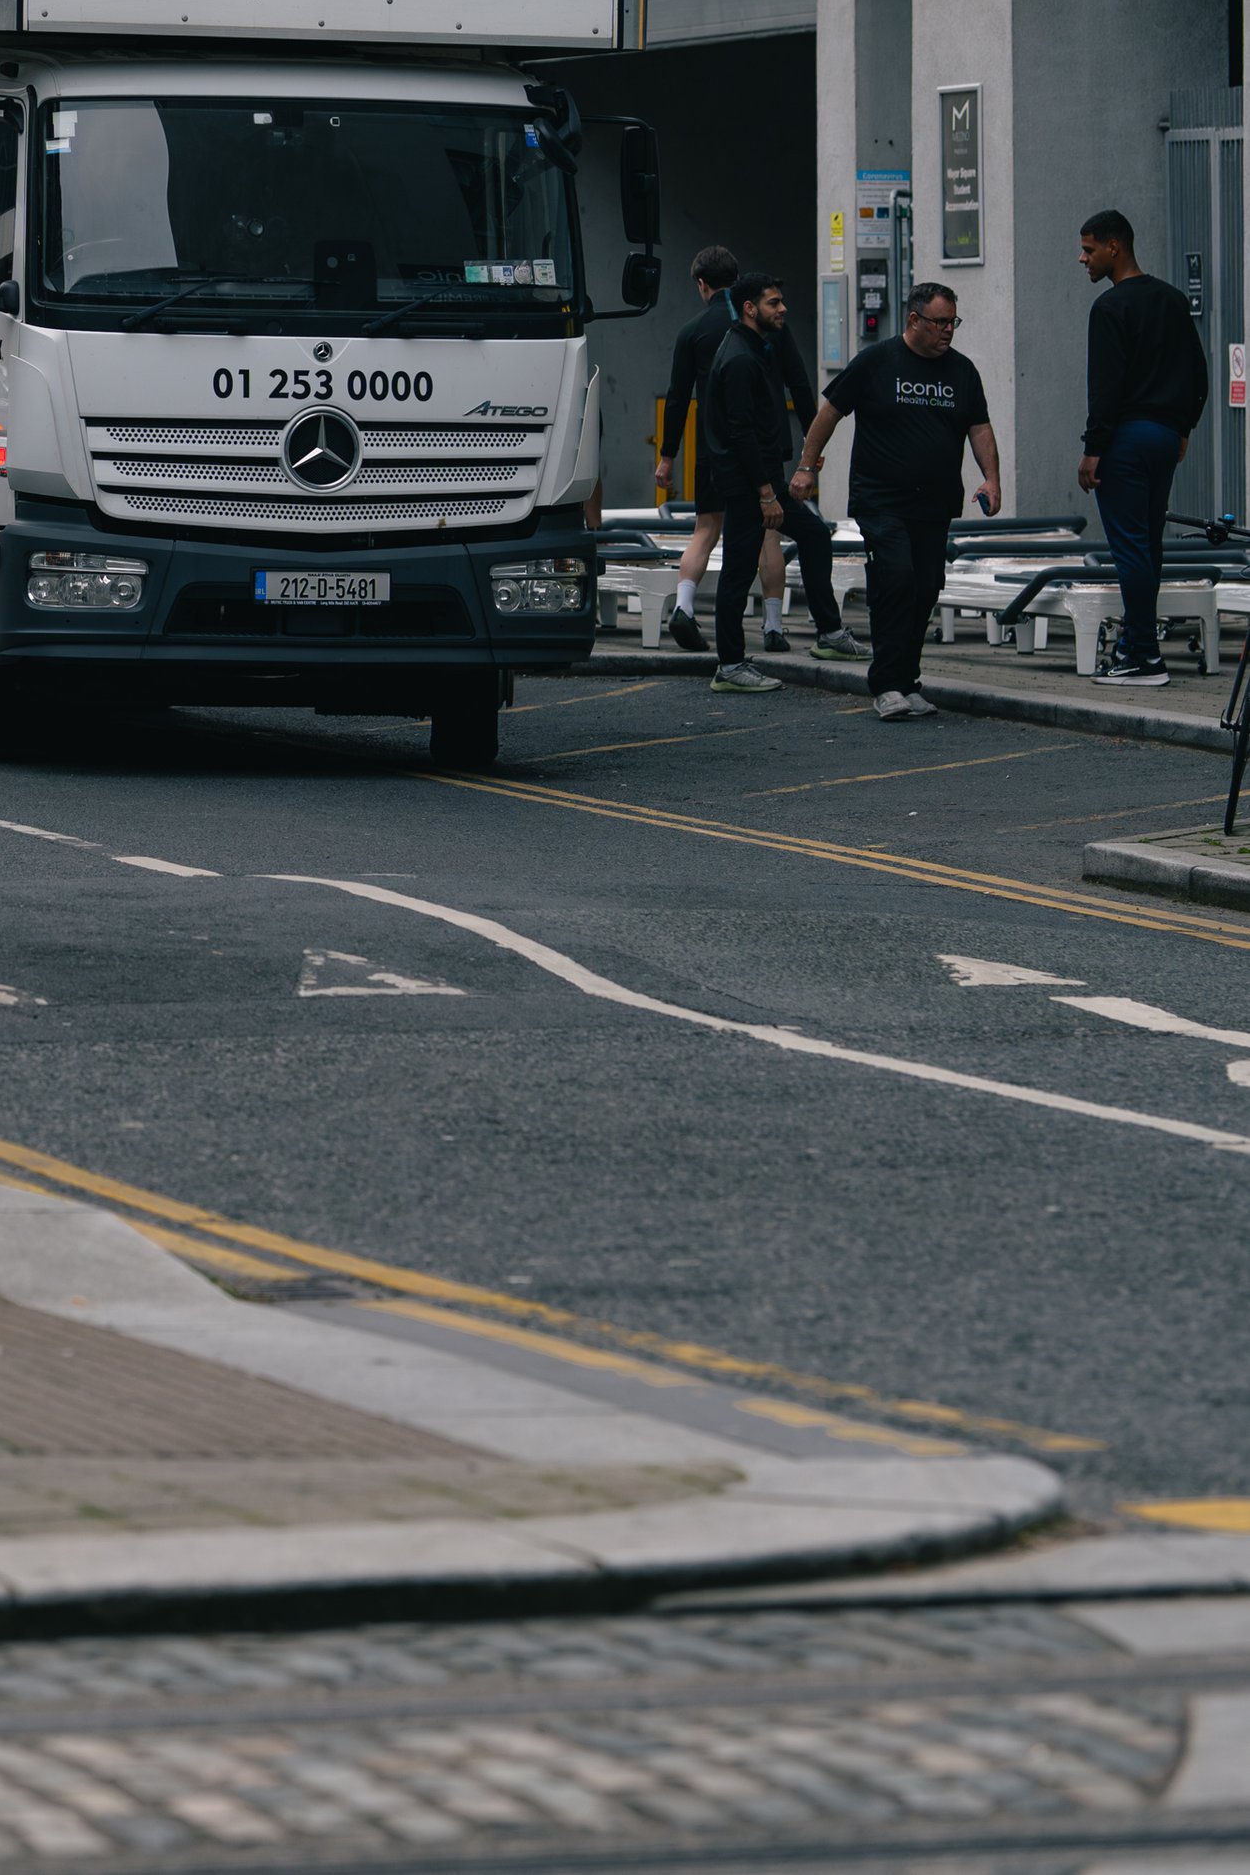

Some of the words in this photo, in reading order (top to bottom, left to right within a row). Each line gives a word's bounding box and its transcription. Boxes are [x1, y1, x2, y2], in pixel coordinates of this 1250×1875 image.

[213, 368, 251, 399] 01
[269, 369, 334, 400] 253
[347, 370, 434, 402] 0000
[896, 377, 954, 398] iconic
[896, 395, 928, 406] Health
[929, 397, 956, 408] Clubs
[280, 577, 377, 599] 212-D-5481
